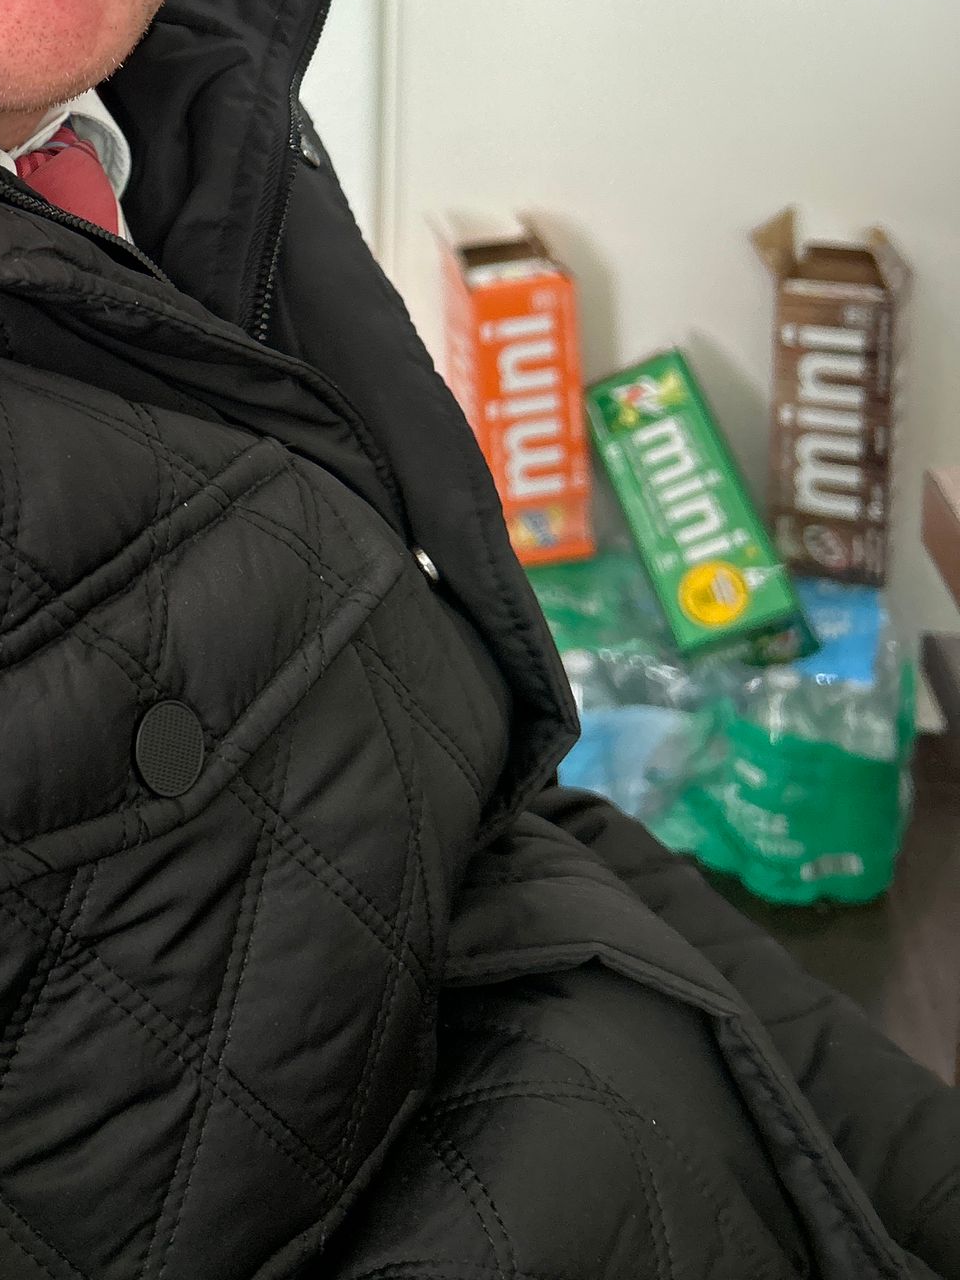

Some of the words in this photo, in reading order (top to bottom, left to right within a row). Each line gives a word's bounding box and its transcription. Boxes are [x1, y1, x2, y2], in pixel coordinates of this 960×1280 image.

[481, 314, 565, 499] mini
[632, 417, 748, 562] mini
[779, 324, 867, 520] mini
